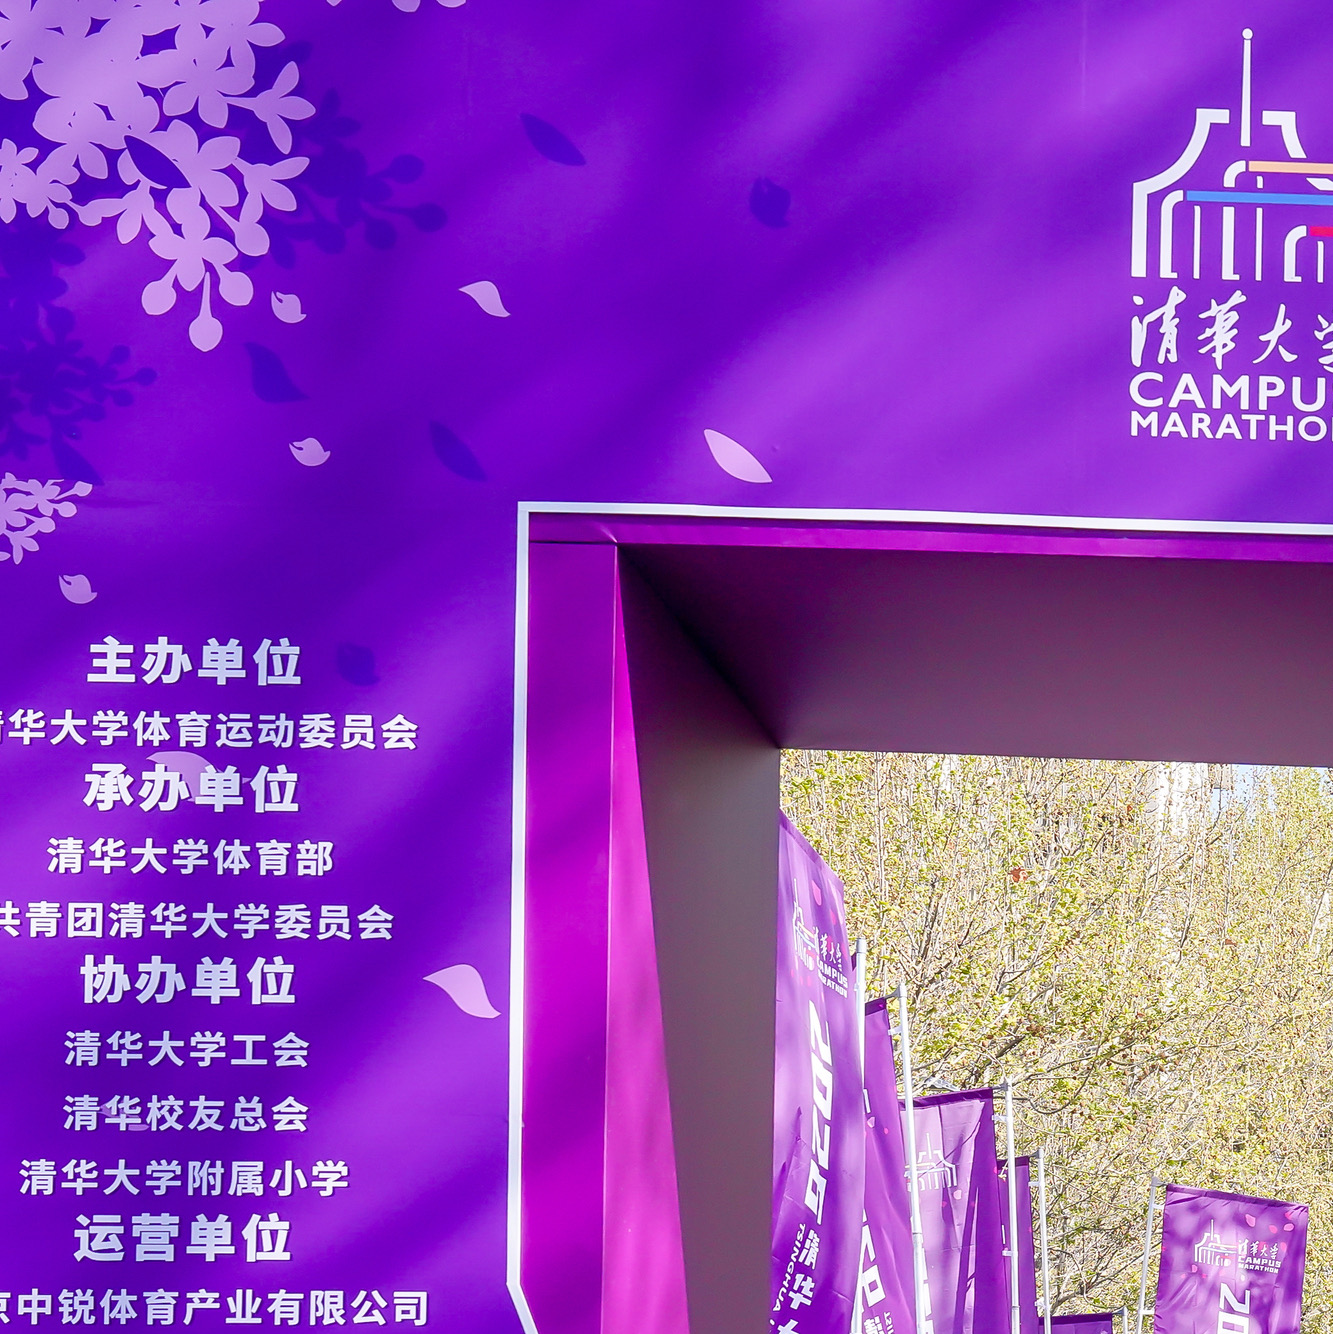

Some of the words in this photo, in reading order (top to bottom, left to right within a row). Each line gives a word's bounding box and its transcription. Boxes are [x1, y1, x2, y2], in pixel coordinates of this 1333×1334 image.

[87, 637, 302, 686] 主办单位
[0, 709, 419, 751] 华大学体育运动委员会
[83, 764, 300, 813] 承办单位
[47, 837, 333, 878] 清华大学体育部
[81, 955, 296, 1006] 协办单位
[64, 1031, 310, 1068] 清华大学工会
[63, 1094, 310, 1132] 清华校友总会
[19, 1159, 349, 1197] 清华大学附属小学
[74, 1213, 292, 1263] 运营单位
[1237, 1256, 1281, 1268] CAMPUS
[1238, 1263, 1279, 1274] MARATHON
